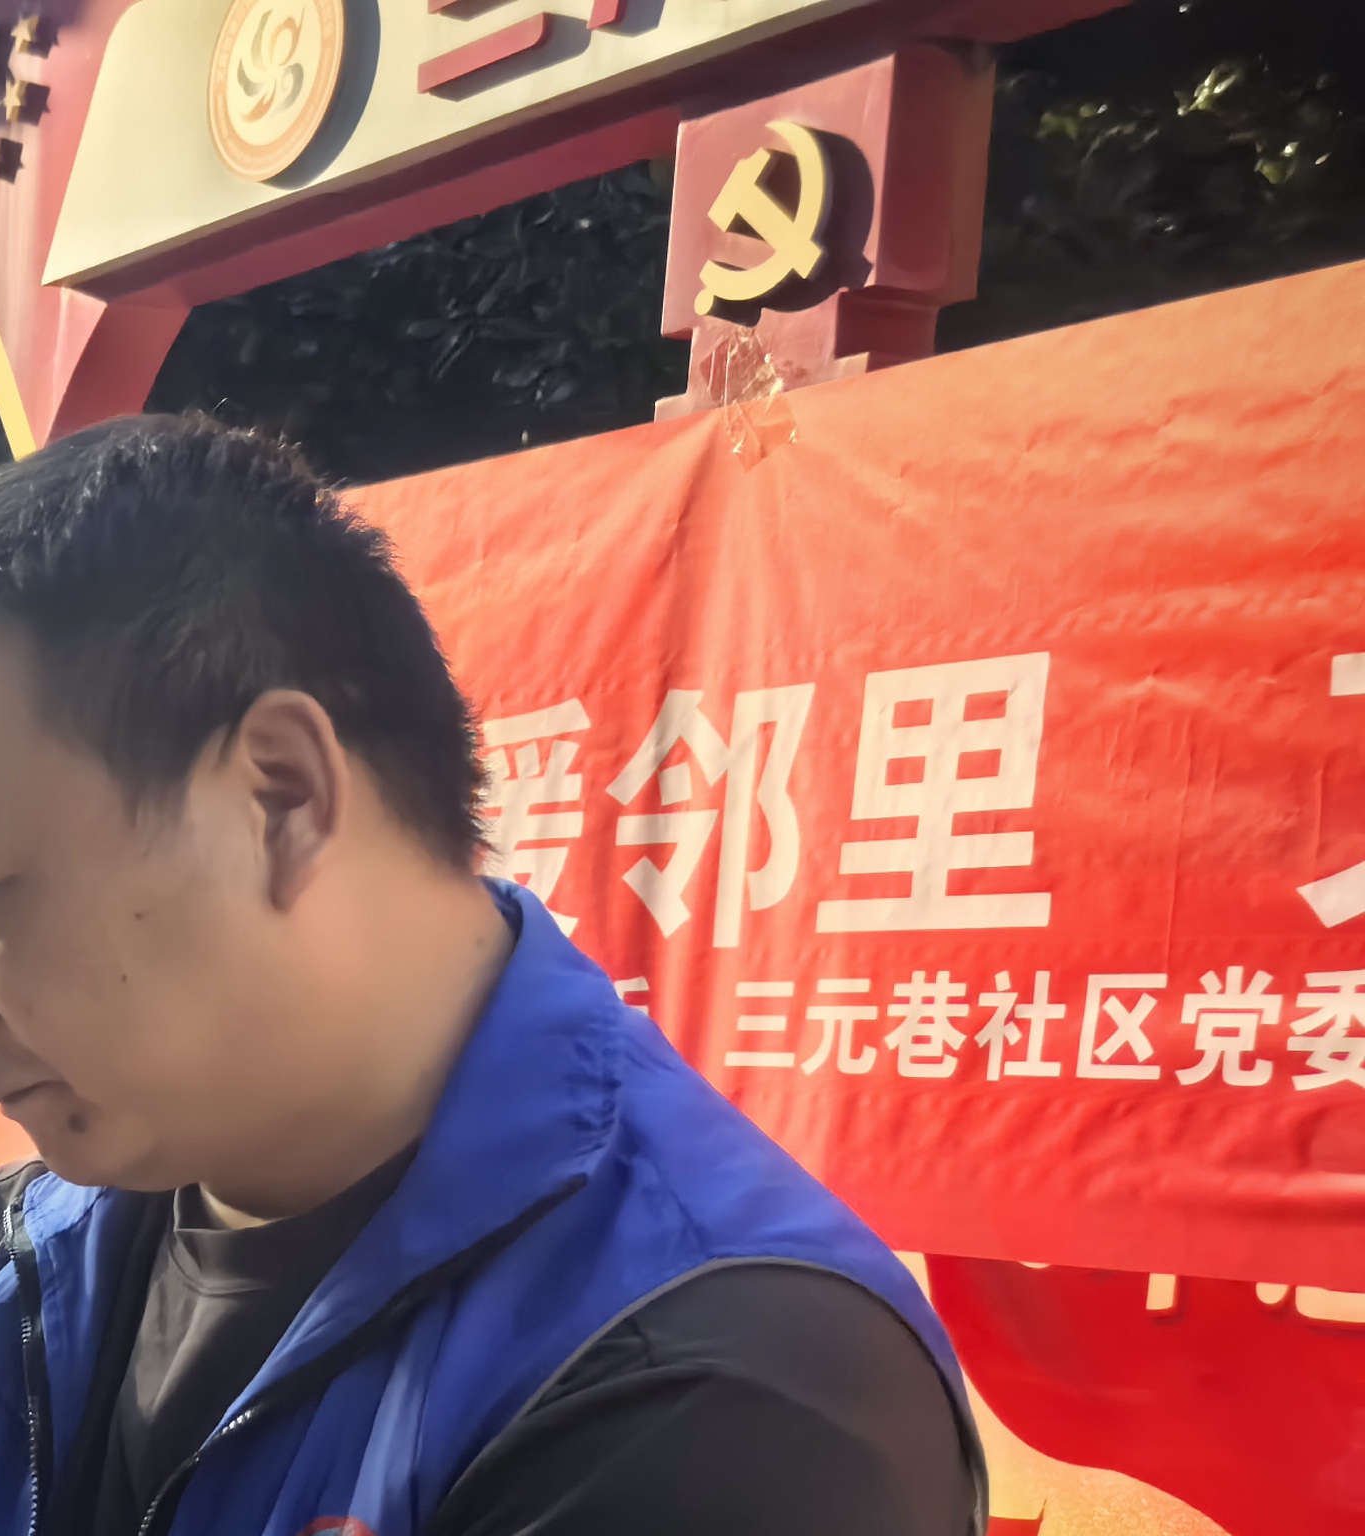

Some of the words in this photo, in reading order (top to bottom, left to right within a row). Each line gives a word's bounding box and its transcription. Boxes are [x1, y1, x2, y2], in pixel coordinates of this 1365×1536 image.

[724, 964, 1365, 1092] 三元巷社区党委
